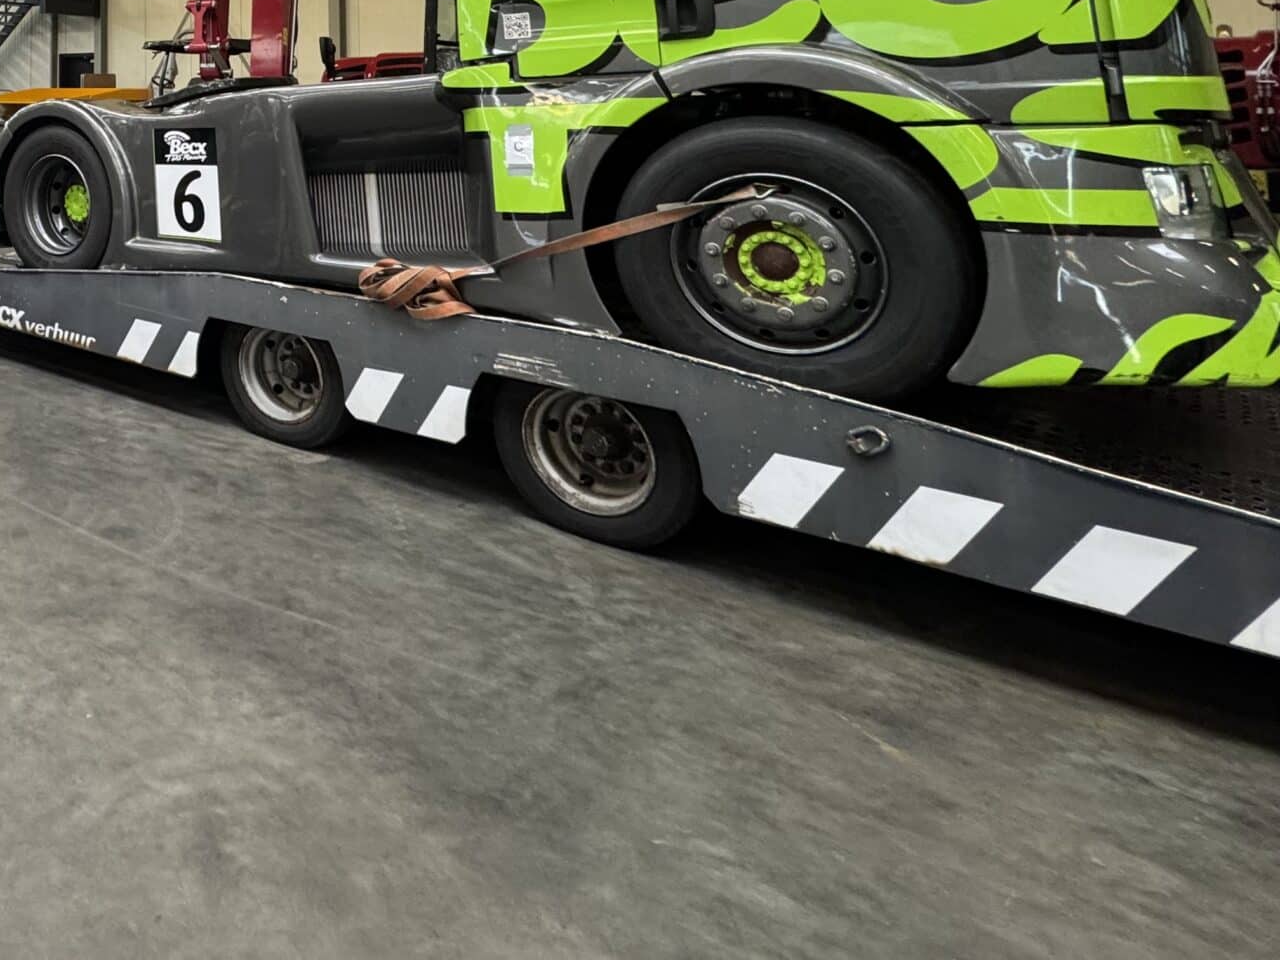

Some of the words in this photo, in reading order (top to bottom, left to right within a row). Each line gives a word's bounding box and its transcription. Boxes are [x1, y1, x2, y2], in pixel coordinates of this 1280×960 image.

[169, 139, 207, 156] Becx
[173, 169, 206, 233] 6
[25, 320, 97, 348] verhuur
